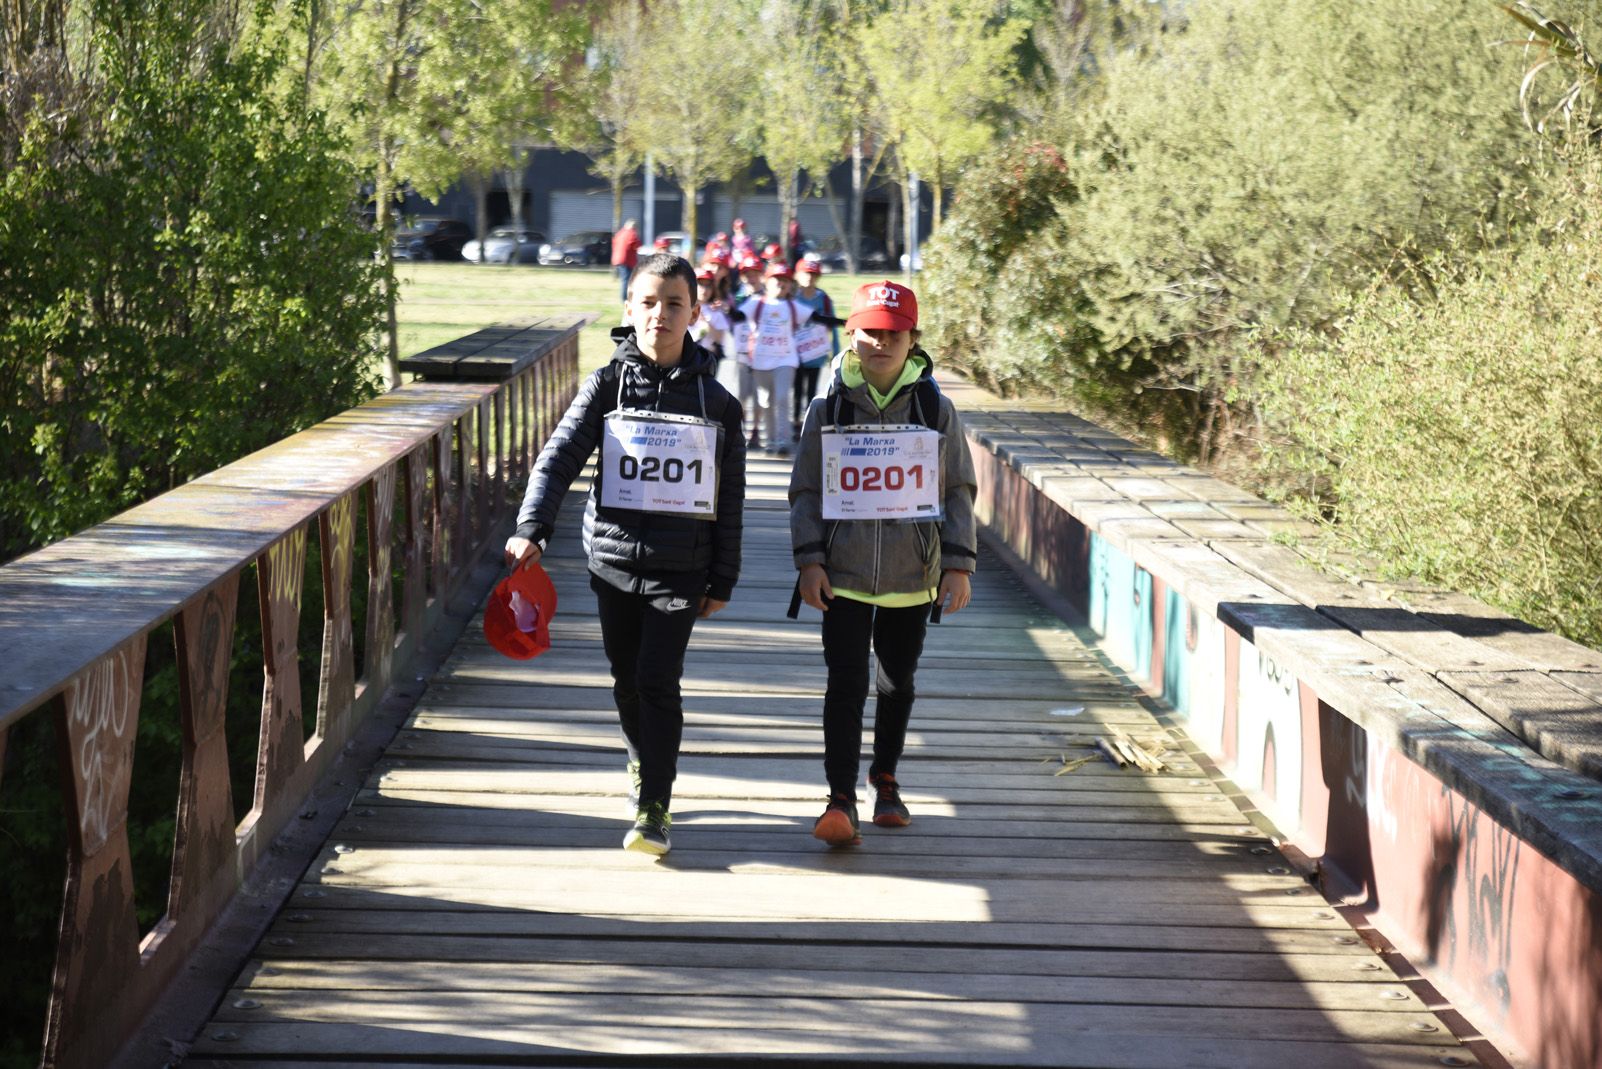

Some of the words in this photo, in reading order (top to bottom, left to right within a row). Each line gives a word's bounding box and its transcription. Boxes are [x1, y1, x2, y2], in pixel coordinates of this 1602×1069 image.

[868, 286, 900, 300] TOT
[644, 425, 678, 436] Marxa
[863, 437, 895, 446] Marxa
[619, 455, 703, 485] 0201
[840, 464, 923, 491] 0201
[671, 596, 689, 608] NIKE
